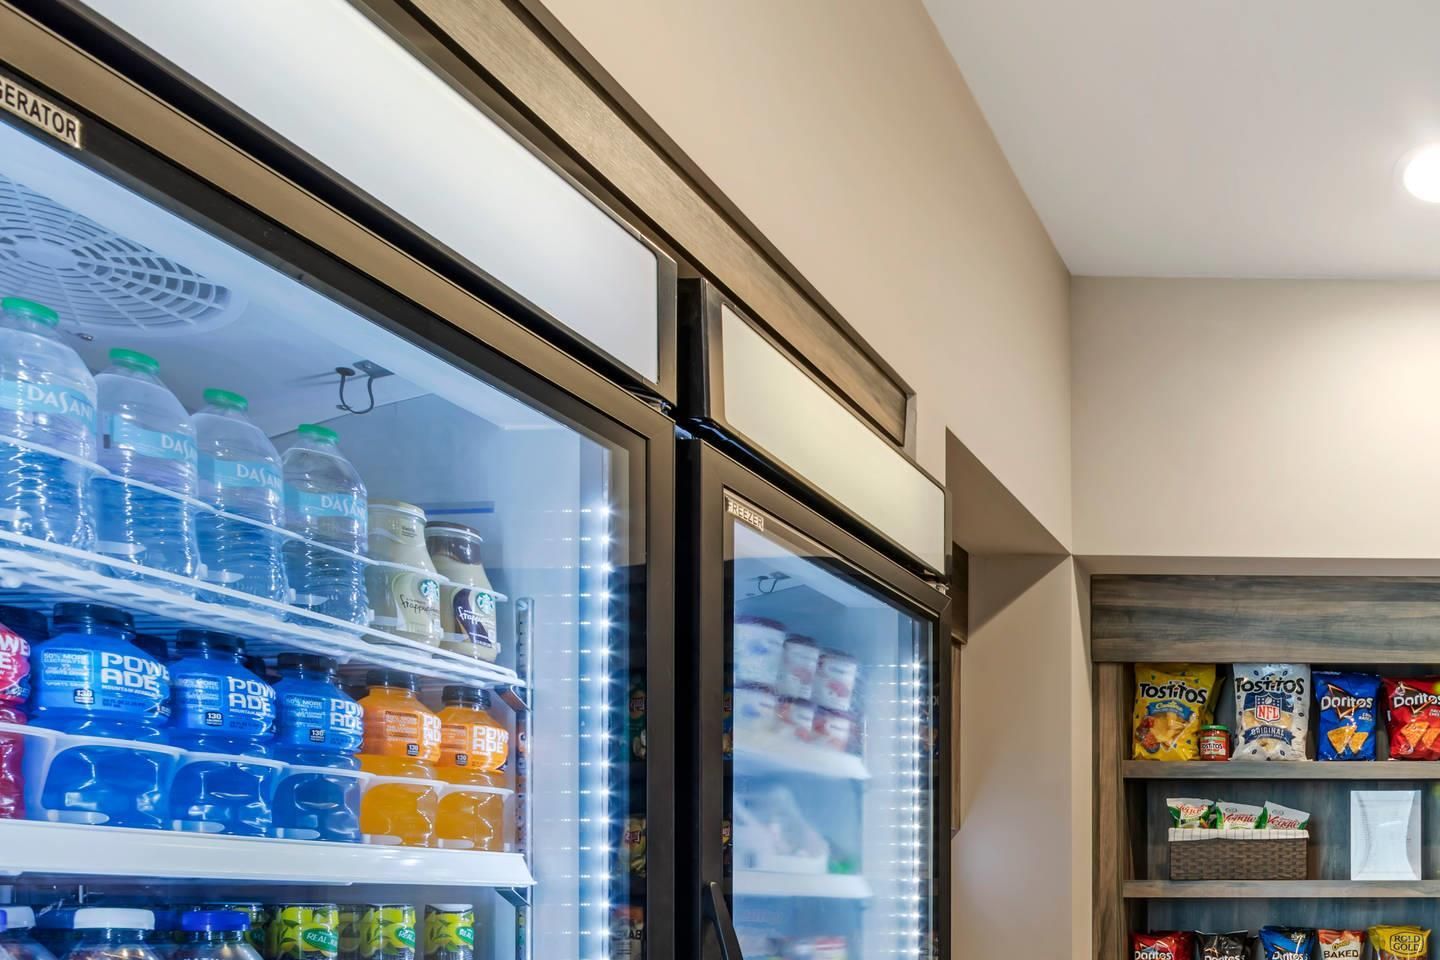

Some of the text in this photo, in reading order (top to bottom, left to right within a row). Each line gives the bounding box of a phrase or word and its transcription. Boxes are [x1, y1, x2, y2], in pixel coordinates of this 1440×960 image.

[728, 501, 764, 530] FREEZER
[228, 692, 271, 713] ADE
[1320, 695, 1374, 710] Doritos
[207, 712, 222, 720] 130
[1258, 705, 1280, 720] NFL
[311, 729, 325, 738] 130
[1250, 729, 1284, 737] ORIGINAL
[306, 932, 328, 943] REAL
[1393, 943, 1420, 952] GOLD
[1135, 950, 1173, 960] Doritos
[1272, 951, 1304, 960] Doritos
[1324, 949, 1359, 959] BAKED
